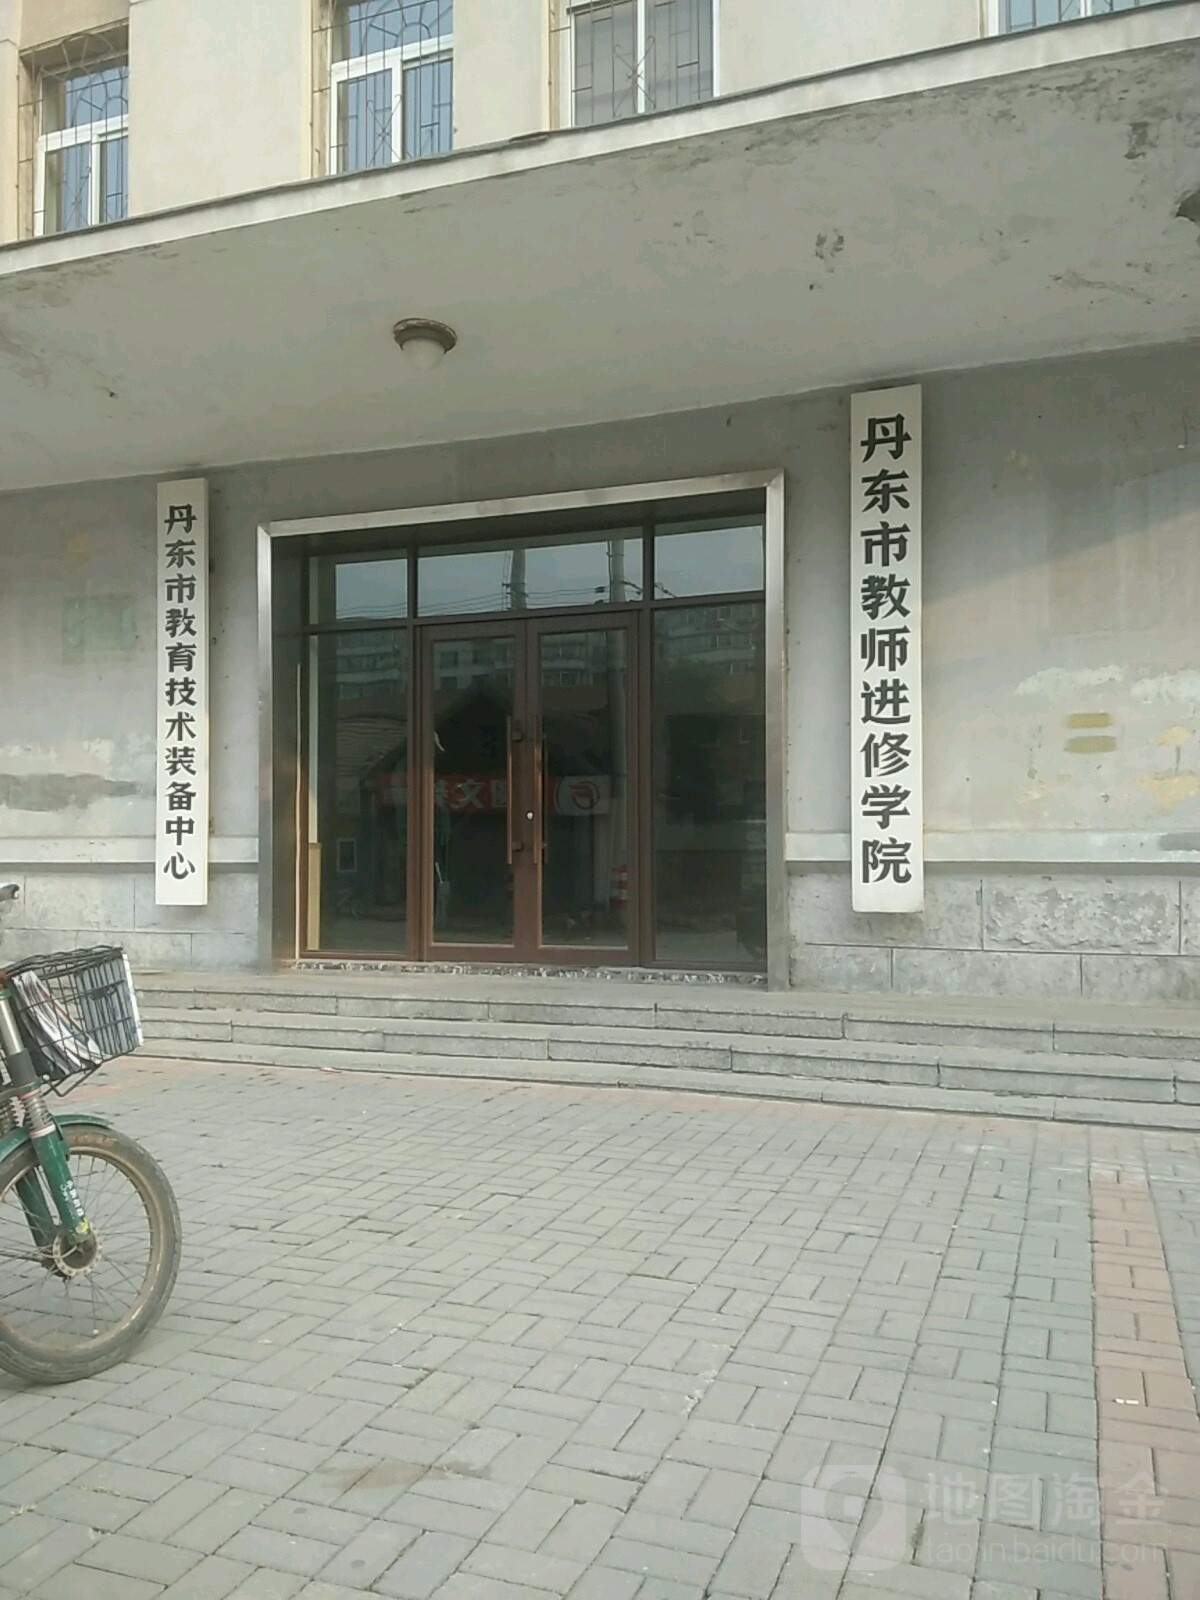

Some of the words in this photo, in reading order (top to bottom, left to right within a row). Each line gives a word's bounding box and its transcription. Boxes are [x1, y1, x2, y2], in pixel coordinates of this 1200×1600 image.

[163, 503, 198, 880] 丹东市教育技术装备中心
[860, 412, 913, 885] 丹东市教师进修学院
